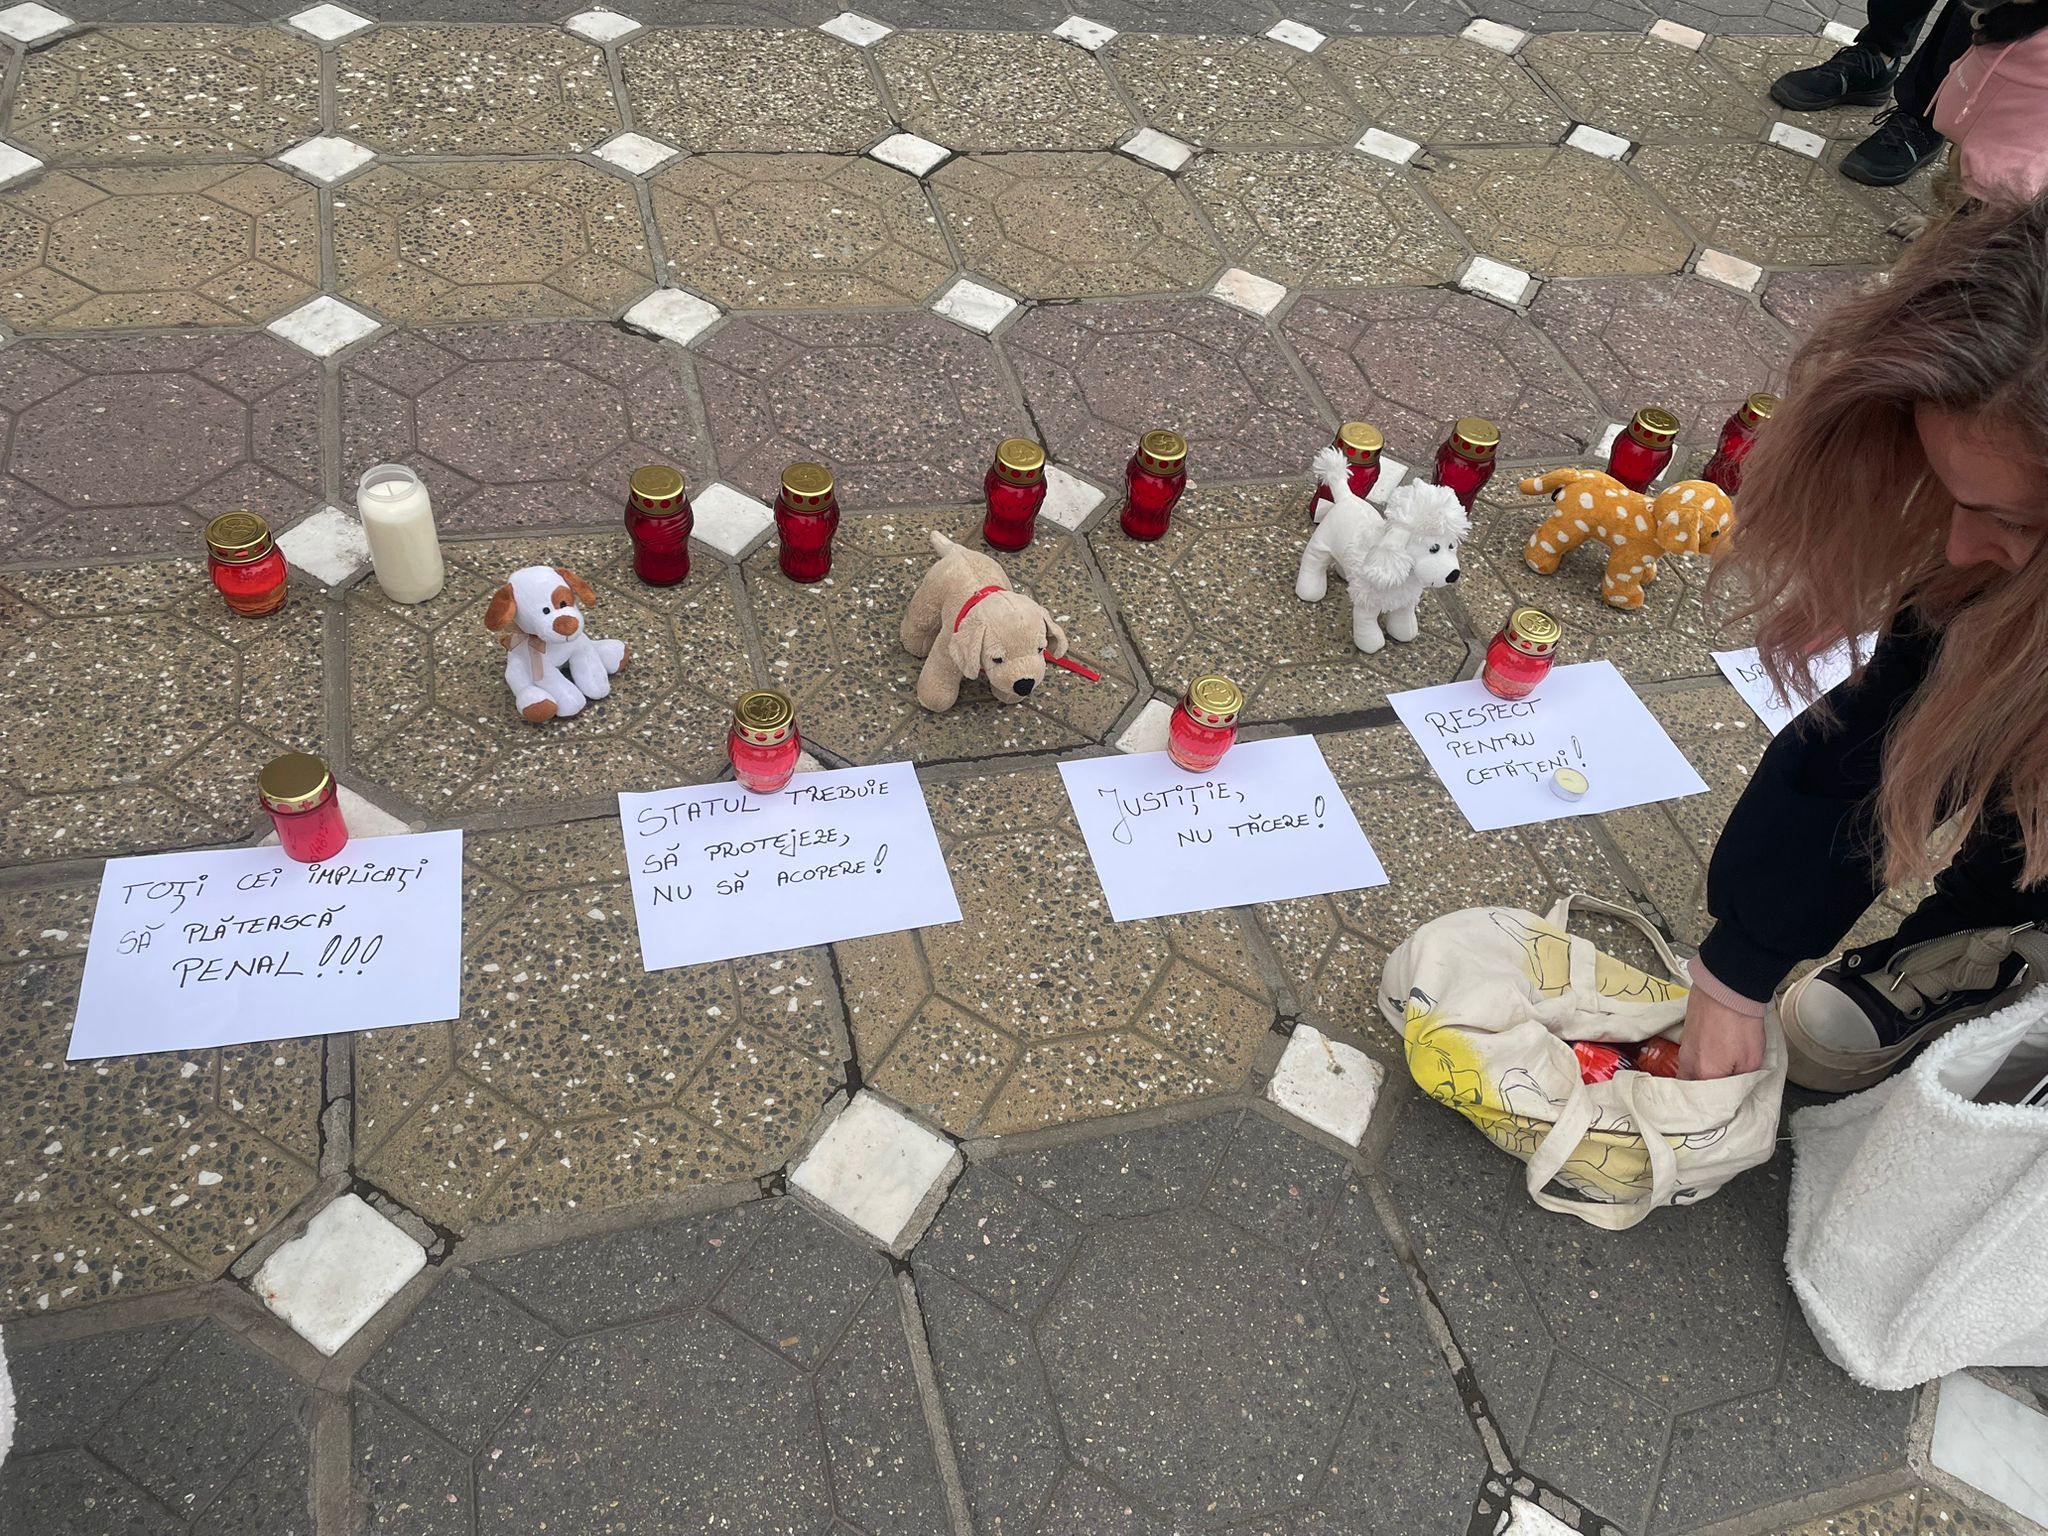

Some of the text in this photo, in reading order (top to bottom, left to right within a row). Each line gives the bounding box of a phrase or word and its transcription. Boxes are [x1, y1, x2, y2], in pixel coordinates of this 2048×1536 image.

[1424, 698, 1542, 737] RESPECT
[1446, 732, 1535, 758] PENTRU
[637, 795, 761, 837] STATUL
[1177, 828, 1213, 848] NU
[641, 843, 681, 875] SĂ
[652, 884, 693, 906] NU
[716, 869, 750, 896] SĂ
[115, 904, 346, 955] SĂ PLĂTEASCĂ
